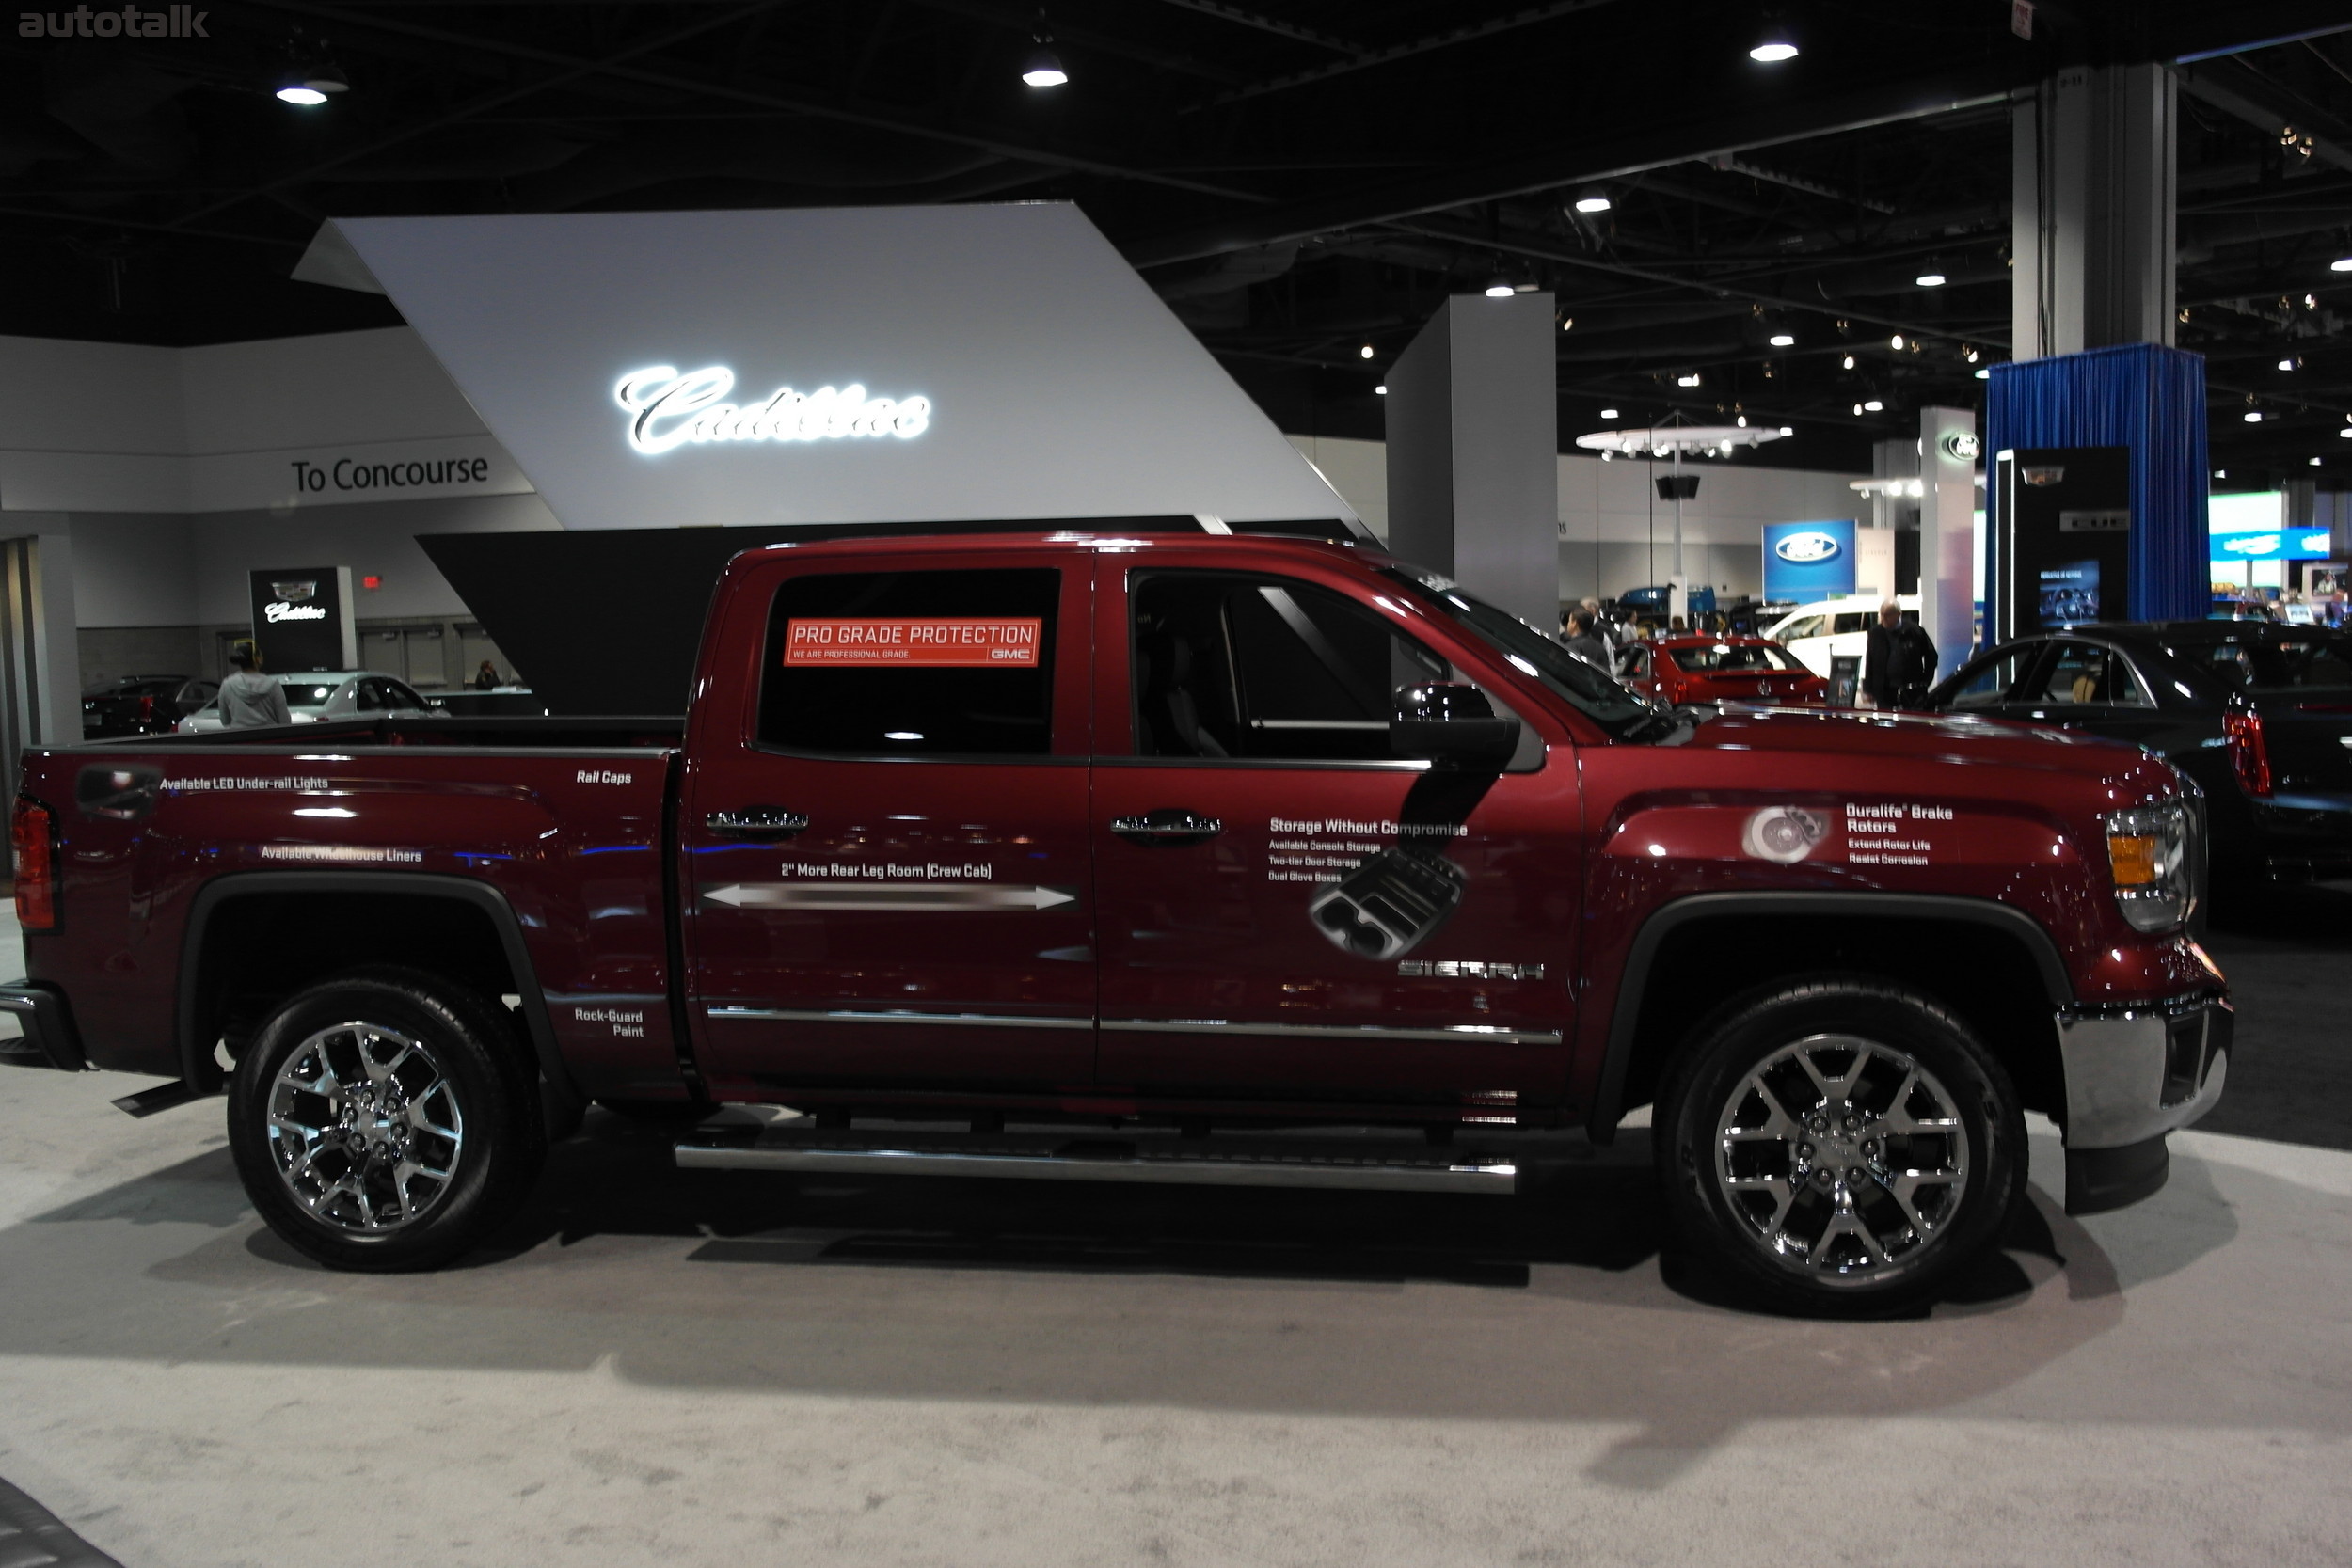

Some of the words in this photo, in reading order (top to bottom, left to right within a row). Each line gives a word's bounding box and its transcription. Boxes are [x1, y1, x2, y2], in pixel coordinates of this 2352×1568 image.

[613, 365, 931, 455] Cadillac
[291, 461, 326, 492] To
[333, 457, 488, 491] Concourse
[794, 626, 833, 644] PRO
[837, 626, 903, 644] GRADE
[909, 626, 1033, 644] PROTECTION
[793, 649, 805, 658] WE
[806, 649, 822, 658] ARE
[823, 649, 881, 659] PROFESSIONAL
[991, 648, 1030, 659] GMC
[160, 777, 211, 791] Available
[213, 777, 235, 790] LED
[236, 777, 292, 790] Under-rail
[294, 776, 329, 791] Lights
[577, 769, 600, 783] Rail
[601, 770, 632, 786] Caps
[1911, 804, 1954, 820] Brake
[1269, 817, 1323, 836] Storage
[1325, 818, 1379, 834] Without
[1381, 819, 1469, 838] Compromise
[1846, 818, 1898, 833] Rotors
[1268, 839, 1310, 851] Available
[1310, 840, 1345, 852] Console
[1346, 841, 1382, 855] Storage
[1848, 837, 1883, 849] Extend
[1883, 838, 1912, 850] Rotor
[1912, 839, 1931, 851] Life
[261, 846, 312, 861] Available
[386, 848, 422, 863] Liners
[1268, 854, 1304, 866] Two-tier
[1304, 855, 1327, 867] Door
[1327, 856, 1362, 870] Storage
[1849, 852, 1881, 864] Resist
[1881, 853, 1929, 866] Corrosion
[781, 862, 796, 877] 2"
[797, 863, 829, 877] More
[830, 863, 860, 878] Rear
[862, 863, 885, 879] Leg
[887, 863, 925, 878] Room
[926, 863, 961, 879] (Crew
[963, 863, 993, 880] Cab)
[1268, 870, 1288, 881] Dual
[1289, 871, 1313, 882] Glove
[1314, 871, 1342, 883] Boxes
[1397, 959, 1545, 980] SIERRA
[574, 1006, 644, 1023] Rock-Guard
[612, 1023, 644, 1037] Paint
